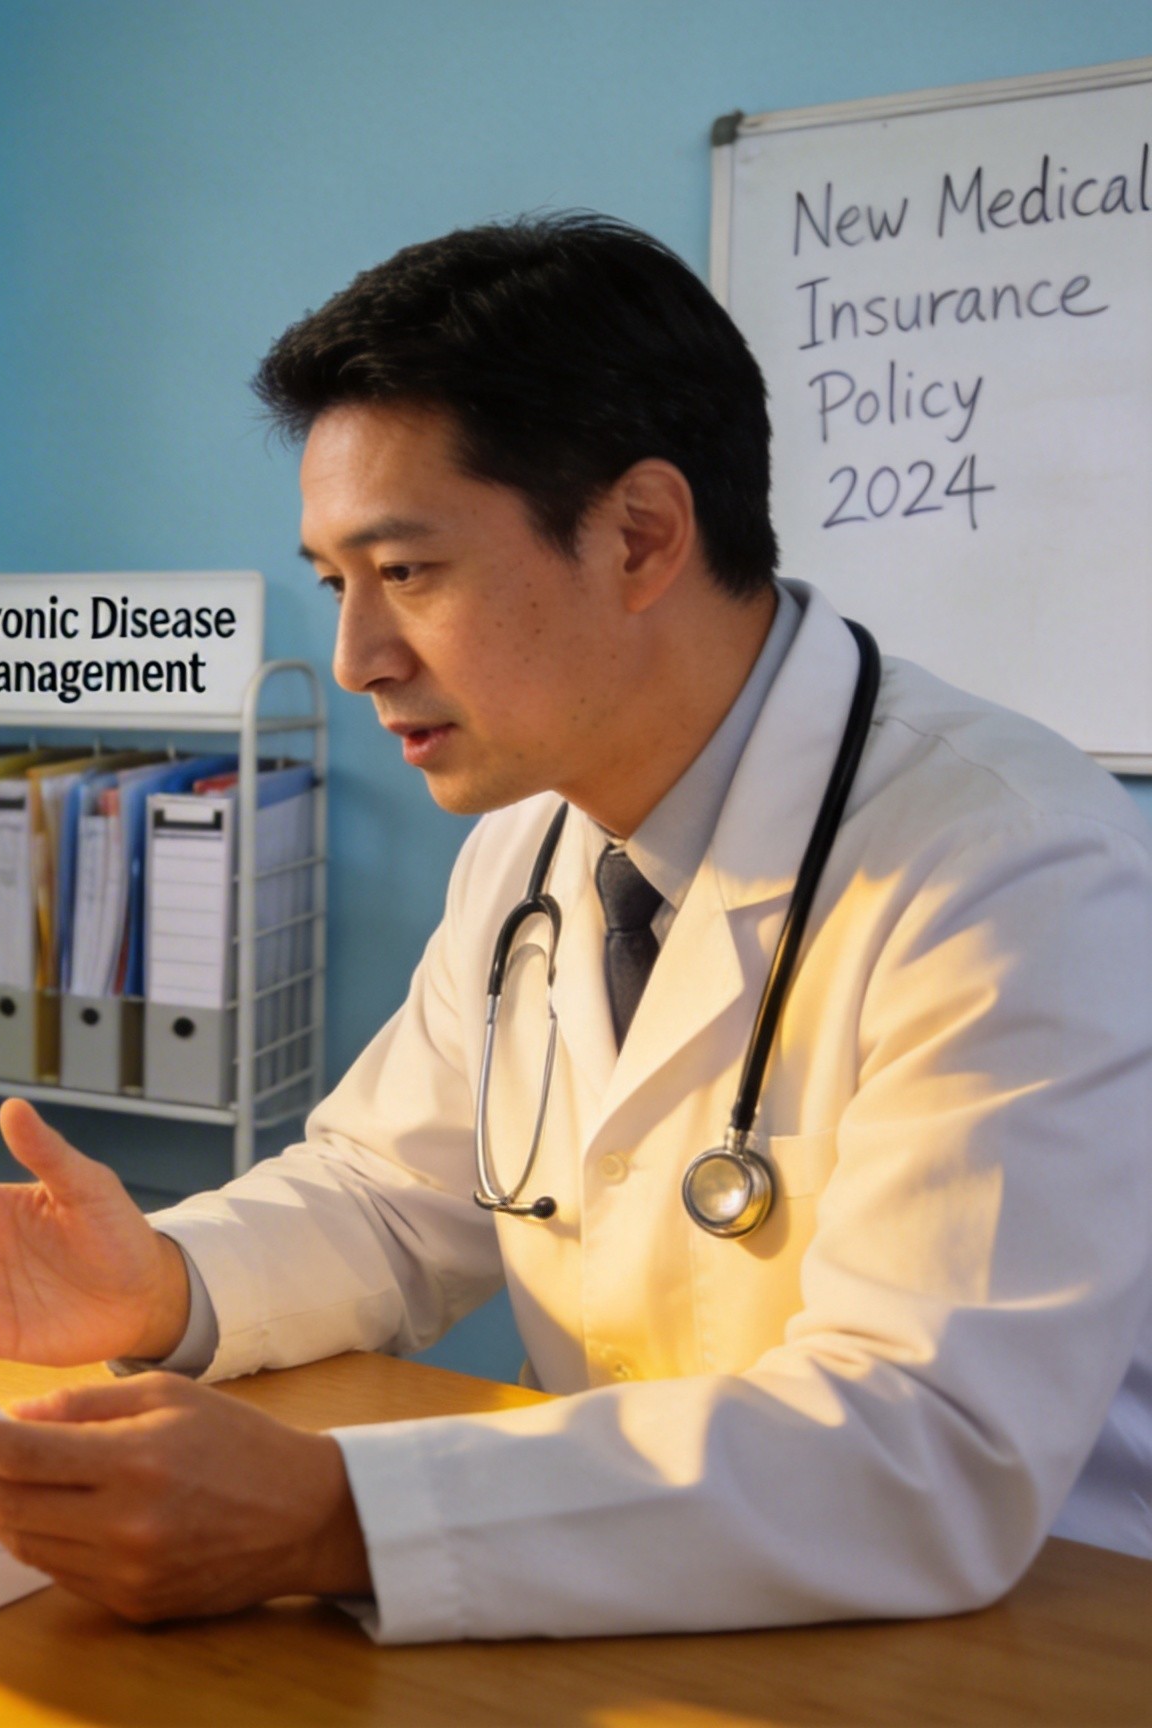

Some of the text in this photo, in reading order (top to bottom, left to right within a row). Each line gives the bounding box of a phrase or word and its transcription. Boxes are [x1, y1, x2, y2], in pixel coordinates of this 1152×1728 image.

[793, 142, 1152, 256] New Medical
[795, 274, 1110, 350] Insurance
[808, 360, 983, 443] Policy
[822, 454, 996, 531] 2024
[90, 595, 237, 640] Disease
